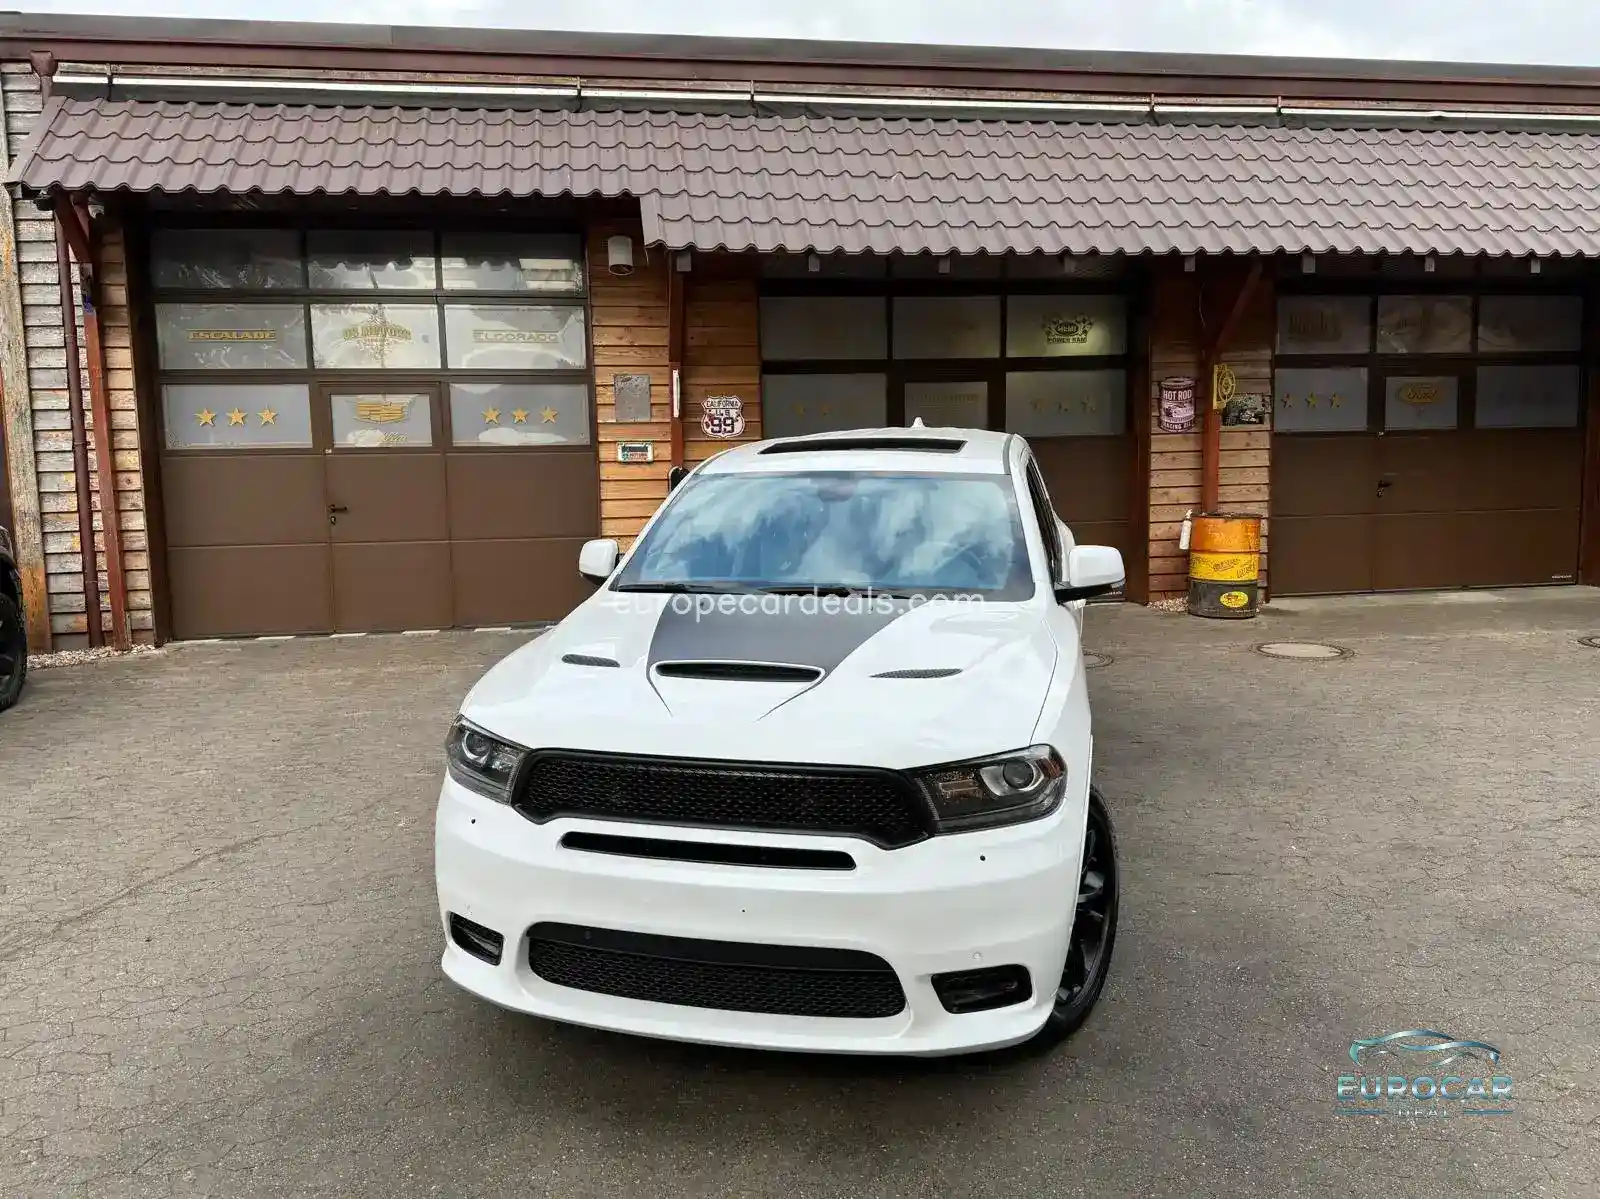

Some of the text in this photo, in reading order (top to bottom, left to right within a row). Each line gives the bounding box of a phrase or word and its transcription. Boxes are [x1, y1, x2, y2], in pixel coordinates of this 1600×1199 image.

[189, 331, 276, 340] ESCALADE
[473, 332, 558, 342] ELDORADO
[1163, 389, 1193, 401] HOT ROD
[706, 400, 739, 408] CALIFORNIA
[711, 416, 735, 434] 99
